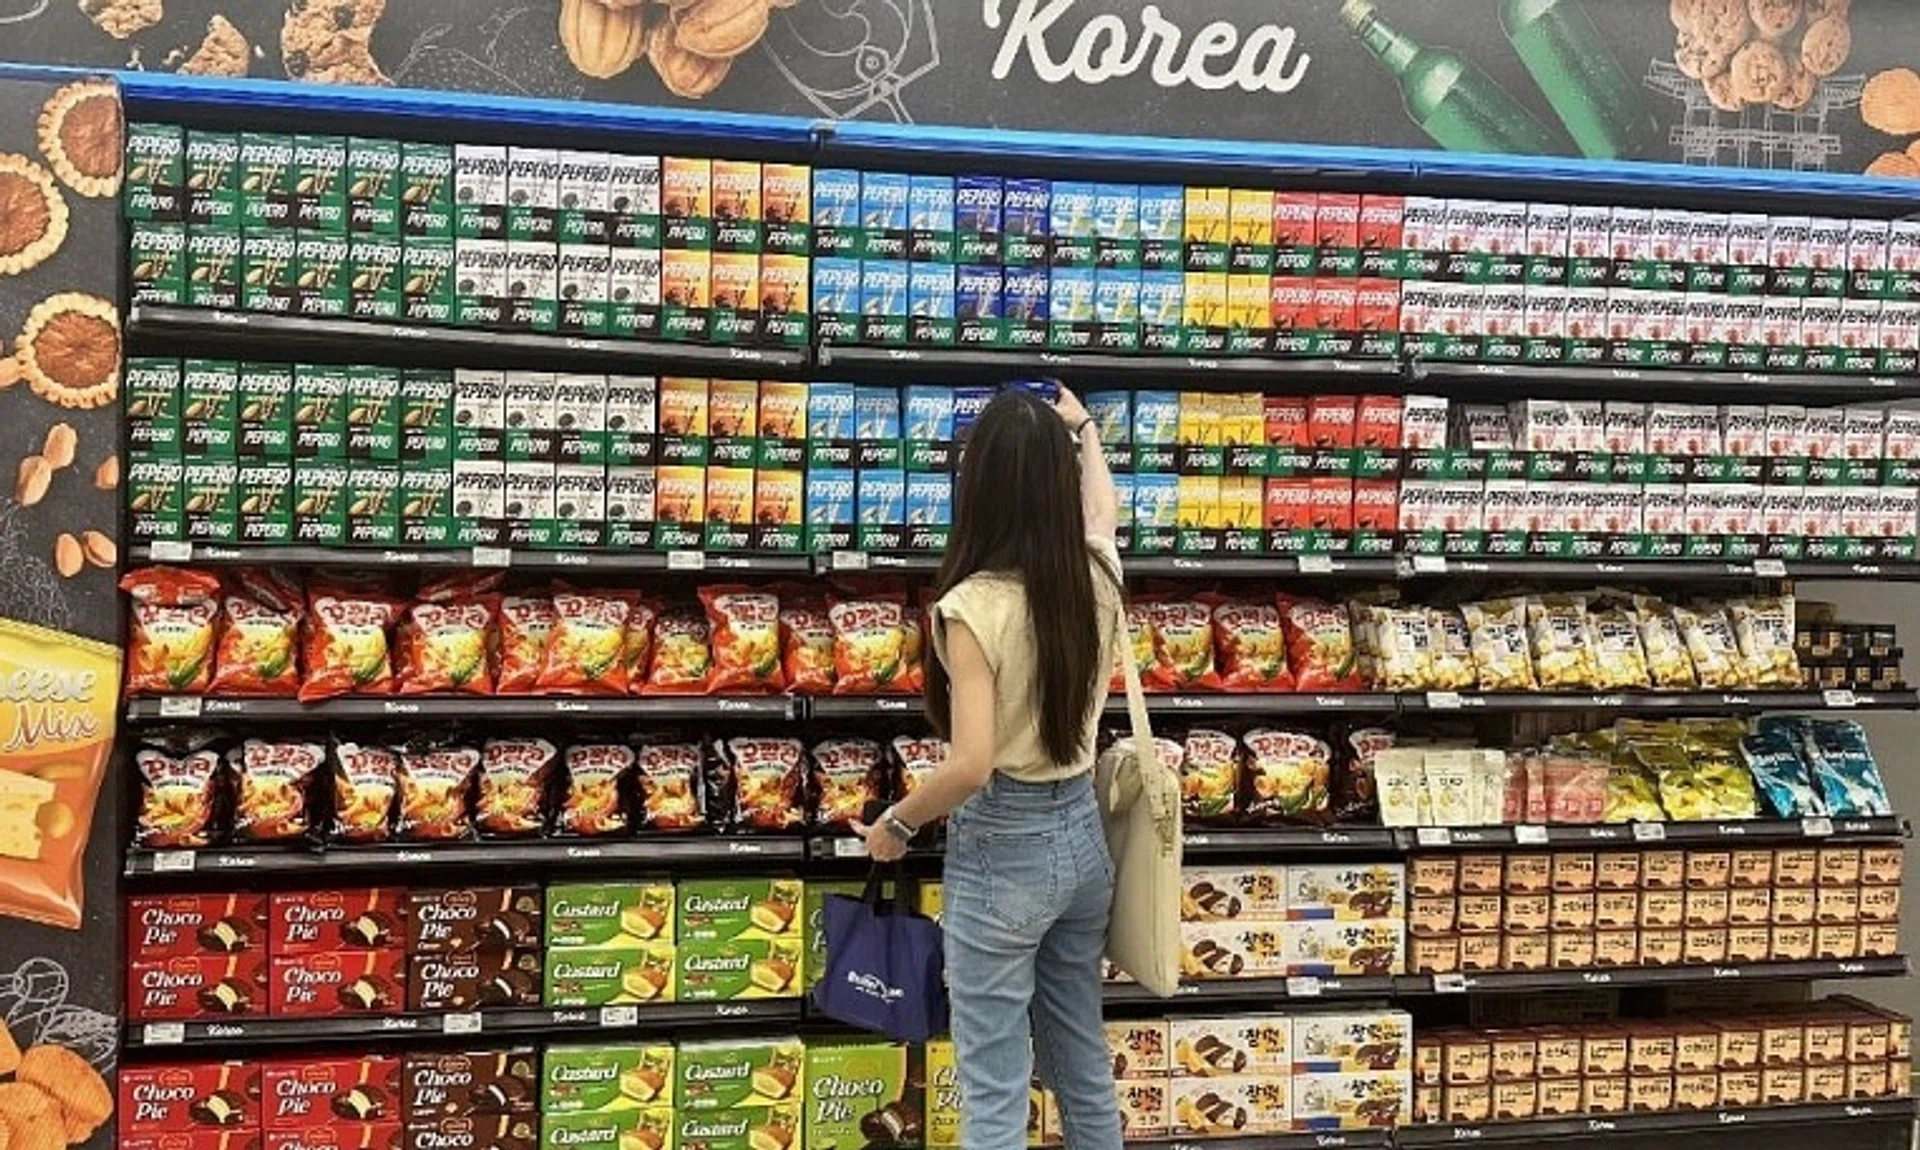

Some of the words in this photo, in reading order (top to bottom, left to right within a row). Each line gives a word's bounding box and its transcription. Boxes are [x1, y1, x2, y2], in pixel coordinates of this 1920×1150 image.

[984, 0, 1309, 92] Korea
[127, 136, 180, 154] PEPERO
[186, 143, 239, 162] PEPERO
[241, 145, 292, 164] PEPERO
[293, 147, 345, 168] PEPERO
[348, 149, 399, 170] PEPERO
[400, 154, 452, 175] PEPERO
[457, 157, 505, 176] PEPERO
[509, 160, 558, 180] PEPERO
[559, 163, 609, 183] PEPERO
[612, 165, 659, 185] PEPERO
[131, 231, 185, 251] PEPERO
[189, 235, 241, 255] PEPERO
[296, 240, 348, 260] PEPERO
[350, 244, 400, 264] PEPERO
[402, 247, 453, 267] PEPERO
[559, 253, 609, 273] PEPERO
[613, 256, 659, 277] PEPERO
[127, 370, 179, 391] PEPERO
[185, 371, 237, 391] PEPERO
[239, 373, 291, 393] PEPERO
[294, 375, 346, 395] PEPERO
[401, 379, 452, 399] PEPERO
[454, 381, 503, 400] PEPERO
[506, 383, 553, 402] PEPERO
[556, 384, 604, 403] PEPERO
[607, 386, 654, 405] PEPERO
[130, 464, 182, 483] PEPERO
[184, 465, 235, 485] PEPERO
[294, 468, 346, 488] PEPERO
[348, 470, 399, 488] PEPERO
[401, 471, 451, 490] PEPERO
[455, 471, 504, 490] PEPERO
[505, 472, 554, 491] PEPERO
[557, 474, 604, 492] PEPERO
[607, 476, 654, 494] PEPERO
[4, 701, 101, 752] Mix
[419, 903, 476, 920] Choco
[553, 902, 617, 918] Custard
[685, 896, 749, 913] Custard
[142, 909, 201, 926] Choco
[285, 906, 344, 923] Choco
[143, 928, 176, 945] Pie
[287, 924, 318, 941] Pie
[419, 922, 452, 939] Pie
[422, 963, 478, 979] Choco
[554, 963, 620, 979] Custard
[685, 955, 749, 971] Custard
[142, 971, 201, 988] Choco
[284, 968, 341, 984] Choco
[144, 990, 177, 1006] Pie
[287, 985, 316, 1002] Pie
[422, 980, 453, 997] Pie
[414, 1070, 471, 1086] Choco
[551, 1064, 617, 1081] Custard
[686, 1063, 749, 1080] Custard
[133, 1084, 194, 1101] Choco
[277, 1079, 335, 1096] Choco
[813, 1075, 883, 1097] Choco
[278, 1098, 310, 1114] Pie
[415, 1088, 446, 1105] Pie
[135, 1102, 168, 1120] Pie
[814, 1100, 853, 1125] Pie
[551, 1128, 616, 1145] Custard
[682, 1121, 746, 1138] Custard
[416, 1131, 473, 1148] Choco
